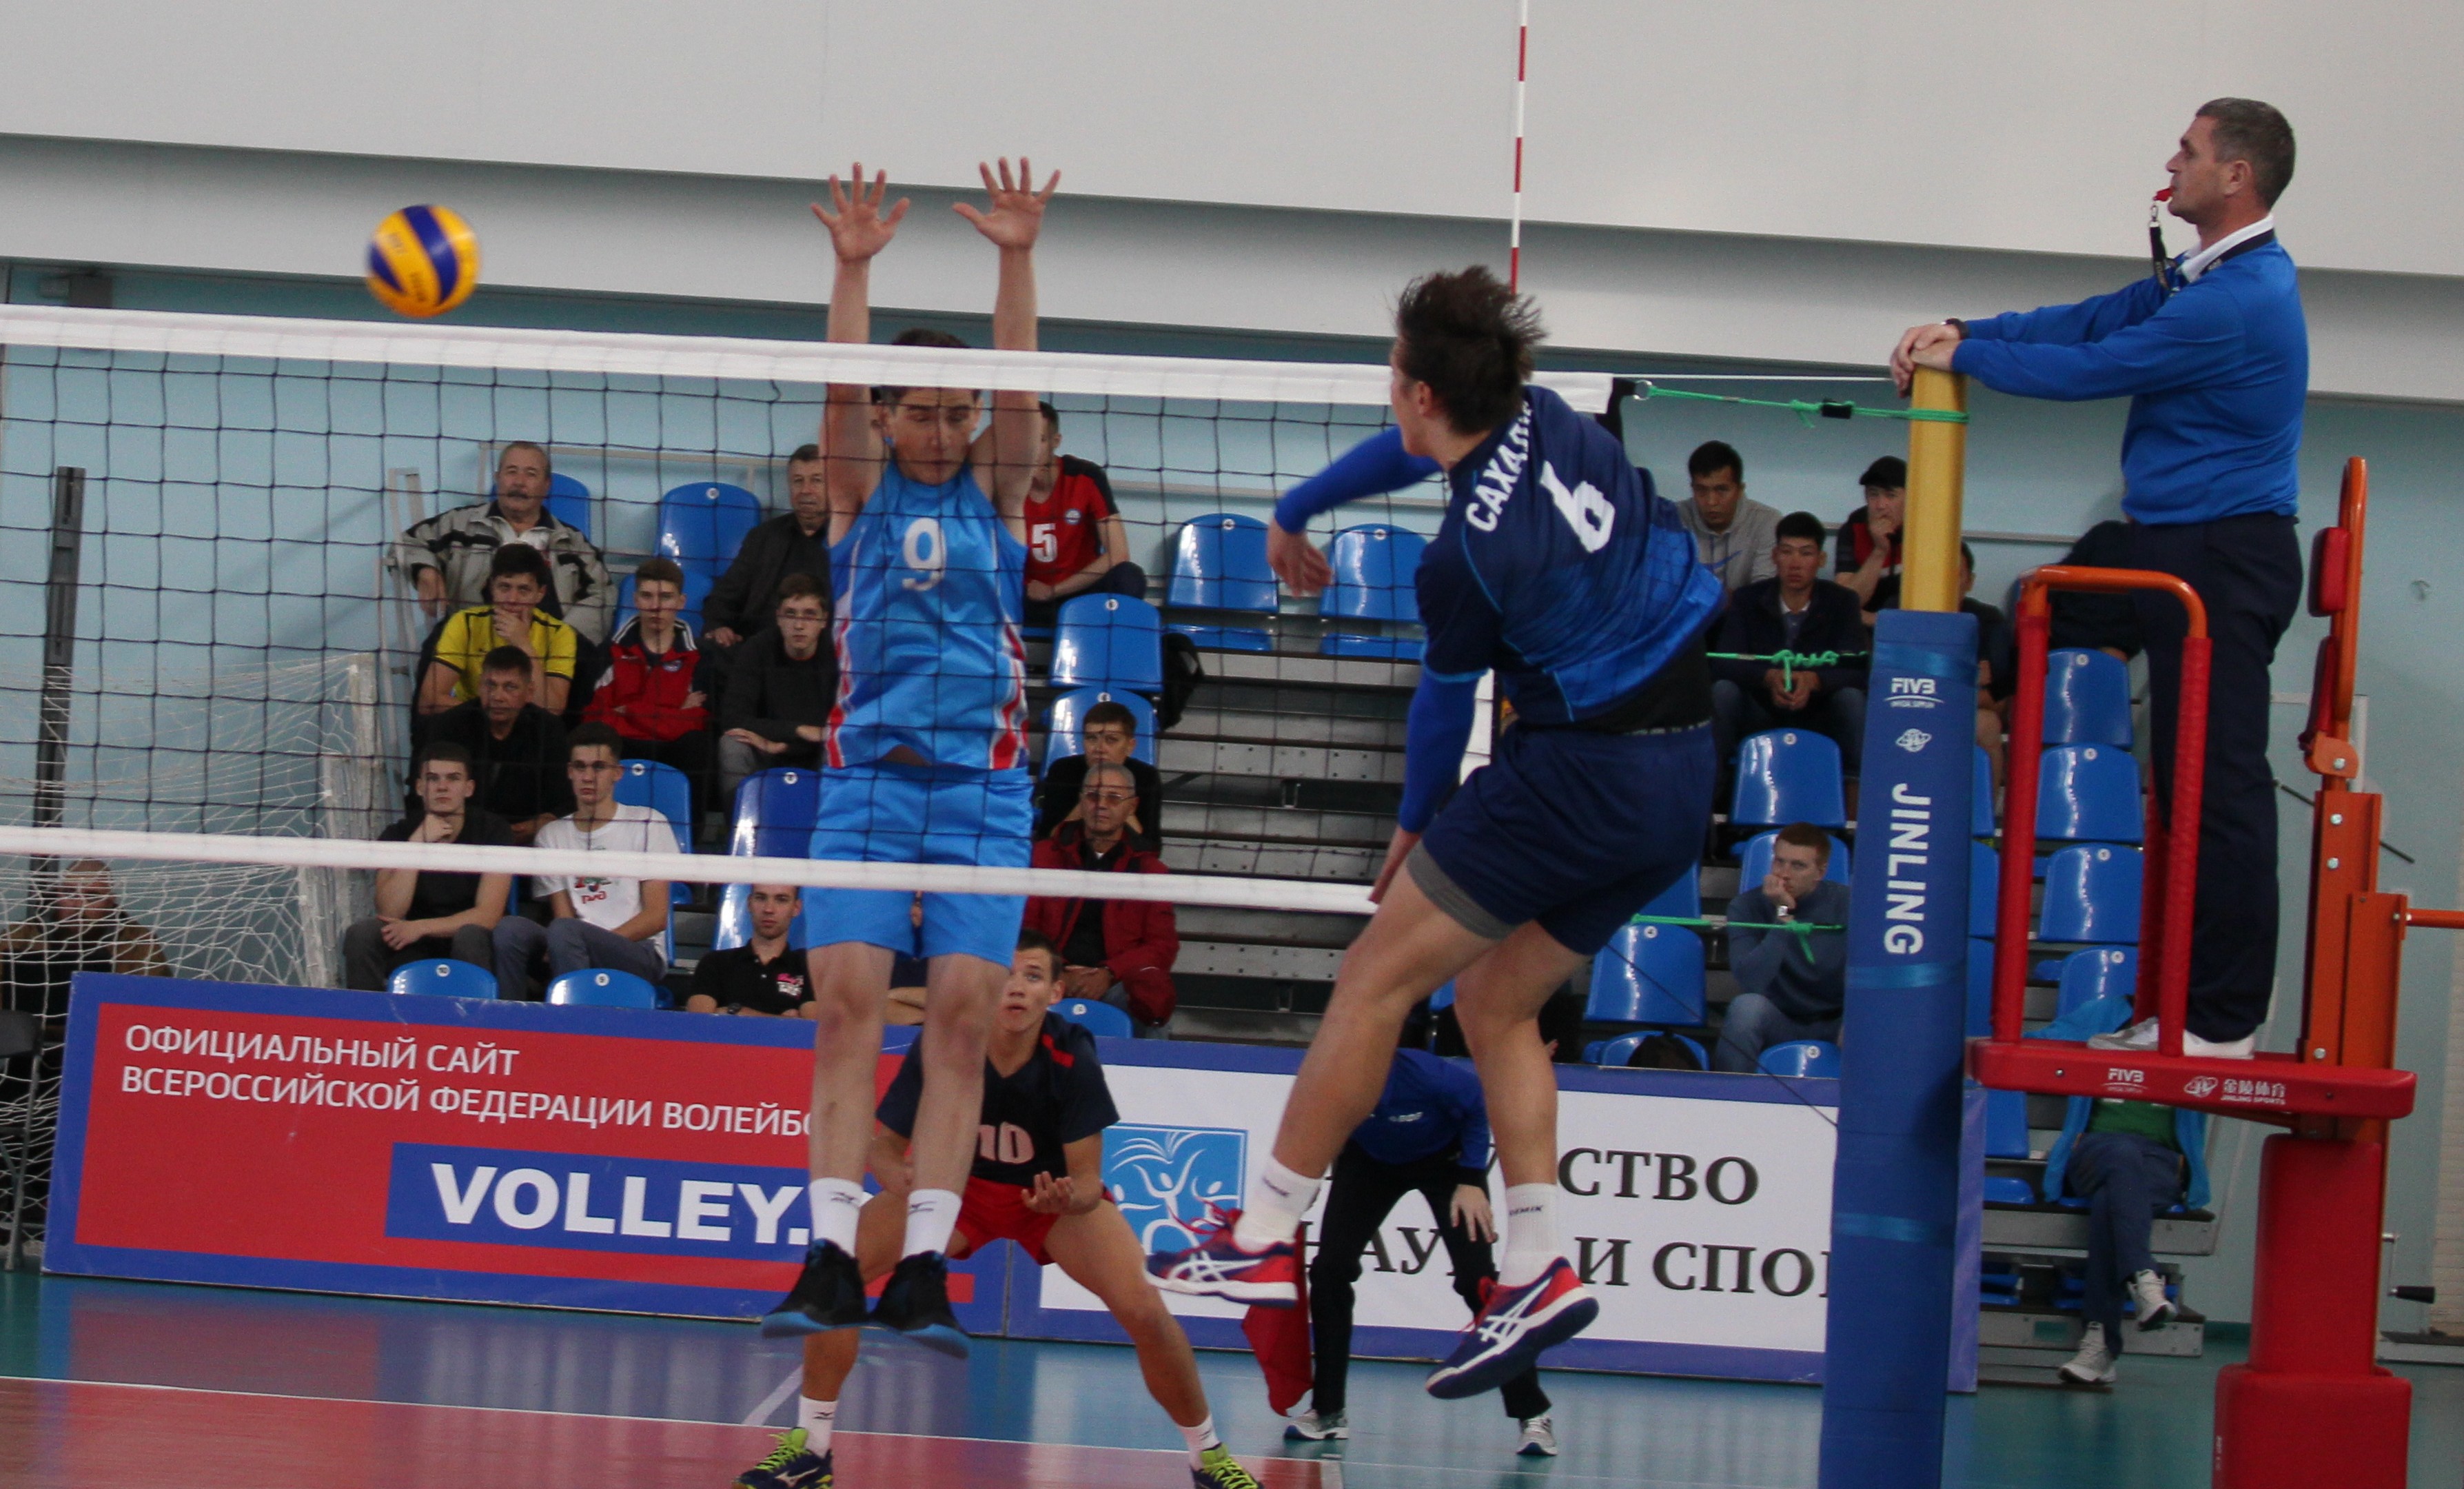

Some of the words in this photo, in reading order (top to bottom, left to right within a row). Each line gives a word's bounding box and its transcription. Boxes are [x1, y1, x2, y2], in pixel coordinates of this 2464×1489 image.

[1540, 460, 1615, 553] 6
[902, 517, 946, 591] 9
[1032, 523, 1057, 563] 5
[1891, 678, 1936, 694] FIVB
[1883, 783, 1931, 955] JINLING
[125, 1024, 417, 1070] ОФИЦИАЛЬНЫЙ
[427, 1042, 520, 1076] САЙТ
[2108, 1068, 2144, 1083] FIVB
[121, 1066, 419, 1112] ВСЕРОССИЙСКОЙ
[429, 1086, 651, 1130] ФЕДЕРАЦИИ
[977, 1122, 1035, 1164] 10
[431, 1162, 810, 1246] VOLLEY.
[1558, 1147, 1759, 1205] СТВО
[1653, 1242, 1829, 1298] СПО
